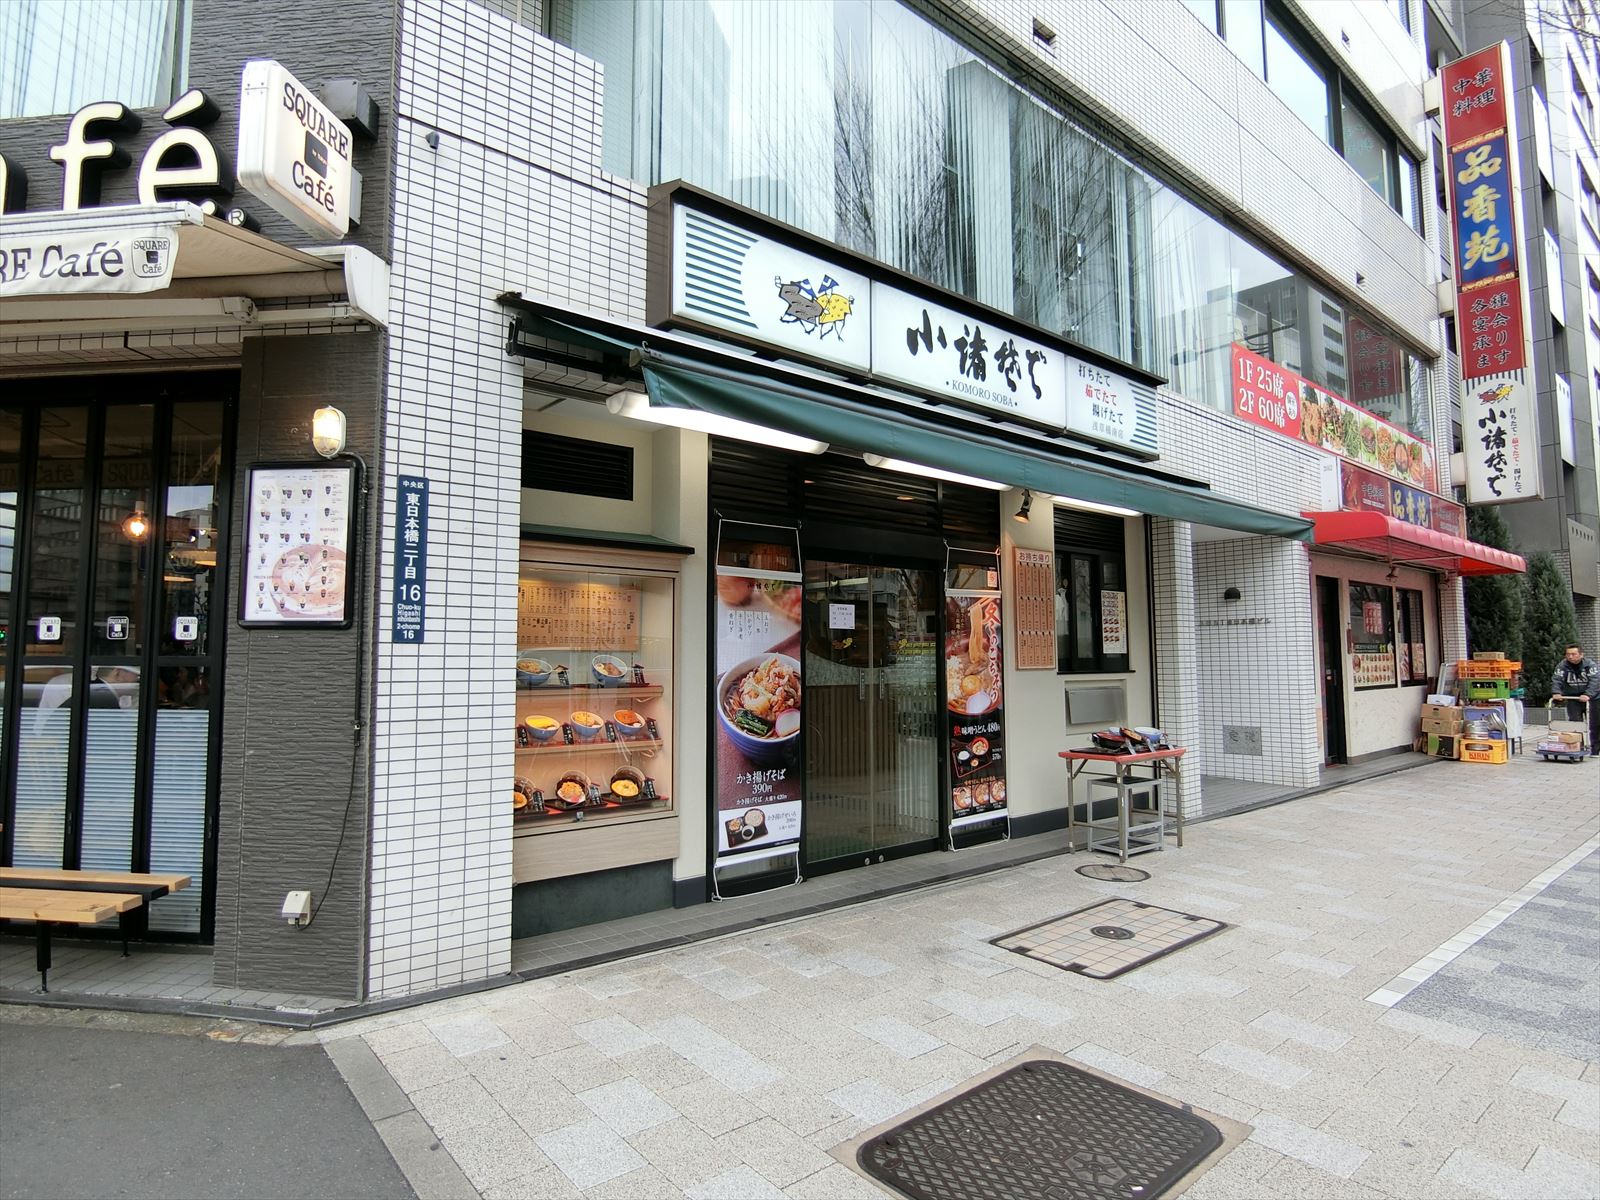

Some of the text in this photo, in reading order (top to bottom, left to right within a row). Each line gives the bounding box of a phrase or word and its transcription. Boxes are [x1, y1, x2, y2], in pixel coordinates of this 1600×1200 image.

[283, 82, 348, 160] SQUARE
[292, 161, 335, 213] Café
[1458, 144, 1509, 270] 品香苑
[133, 239, 168, 252] SQUARE
[39, 241, 124, 279] Café
[142, 263, 162, 275] Café
[1078, 363, 1111, 388] 打ちたて
[1238, 357, 1254, 384] 1F
[952, 379, 991, 401] KOMORO
[1239, 387, 1255, 414] 2F
[403, 480, 424, 489] 中央区
[403, 493, 421, 580] 東日本橋二丁目
[400, 584, 421, 601] 16
[403, 630, 414, 639] 16
[1469, 752, 1490, 760] KIRIN
[736, 768, 786, 785] かき揚げそば
[752, 783, 773, 794] 390円
